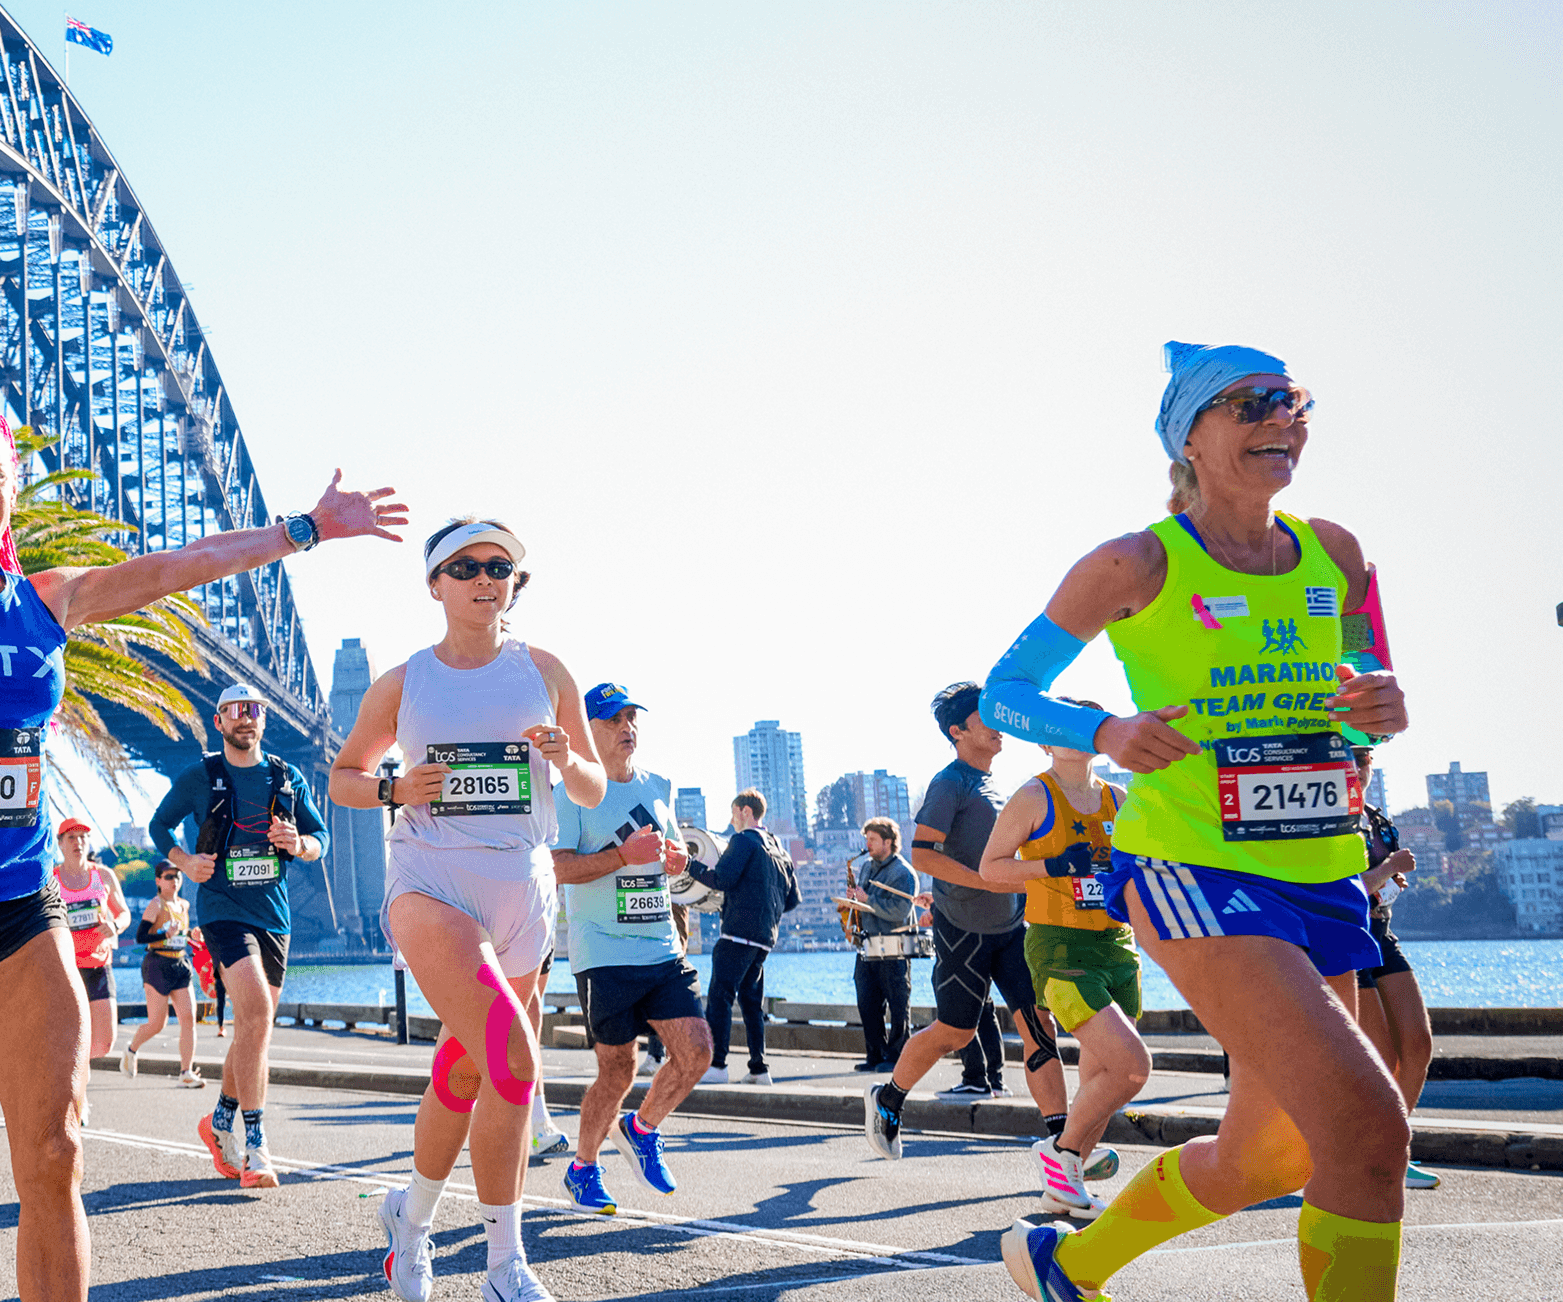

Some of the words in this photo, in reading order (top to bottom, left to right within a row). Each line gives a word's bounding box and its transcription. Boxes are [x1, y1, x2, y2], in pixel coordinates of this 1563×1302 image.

[1210, 662, 1339, 687] MARATHO
[1190, 693, 1266, 716] TEAM
[994, 702, 1030, 731] SEVEN
[13, 745, 32, 754] TATA
[1226, 745, 1261, 763] tcs
[434, 750, 456, 762] tcs
[30, 781, 38, 792] F
[449, 776, 510, 796] 28165
[521, 781, 527, 790] E
[1252, 781, 1338, 811] 21476
[1350, 787, 1358, 799] A
[1224, 794, 1234, 805] 2
[1280, 824, 1296, 833] tcs
[238, 864, 271, 876] 27091
[621, 879, 636, 888] tcs
[629, 896, 664, 909] 26639
[72, 912, 94, 924] 27811
